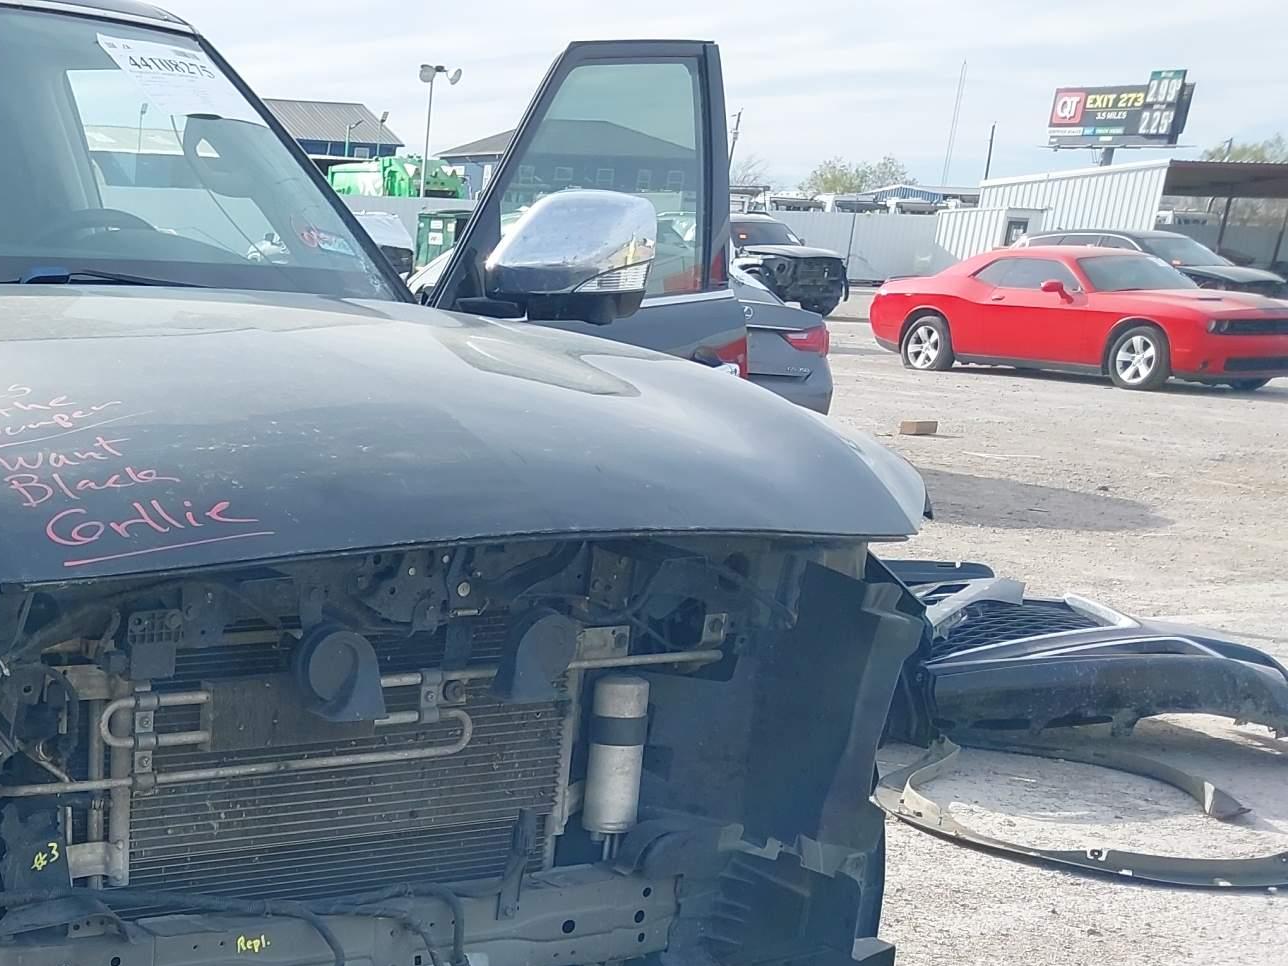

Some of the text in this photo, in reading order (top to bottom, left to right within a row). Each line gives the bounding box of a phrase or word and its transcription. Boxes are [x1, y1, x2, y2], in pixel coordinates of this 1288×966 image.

[128, 56, 215, 79] 44108275
[1056, 96, 1080, 120] QT
[1086, 94, 1117, 109] EXIT
[1118, 92, 1144, 108] 273
